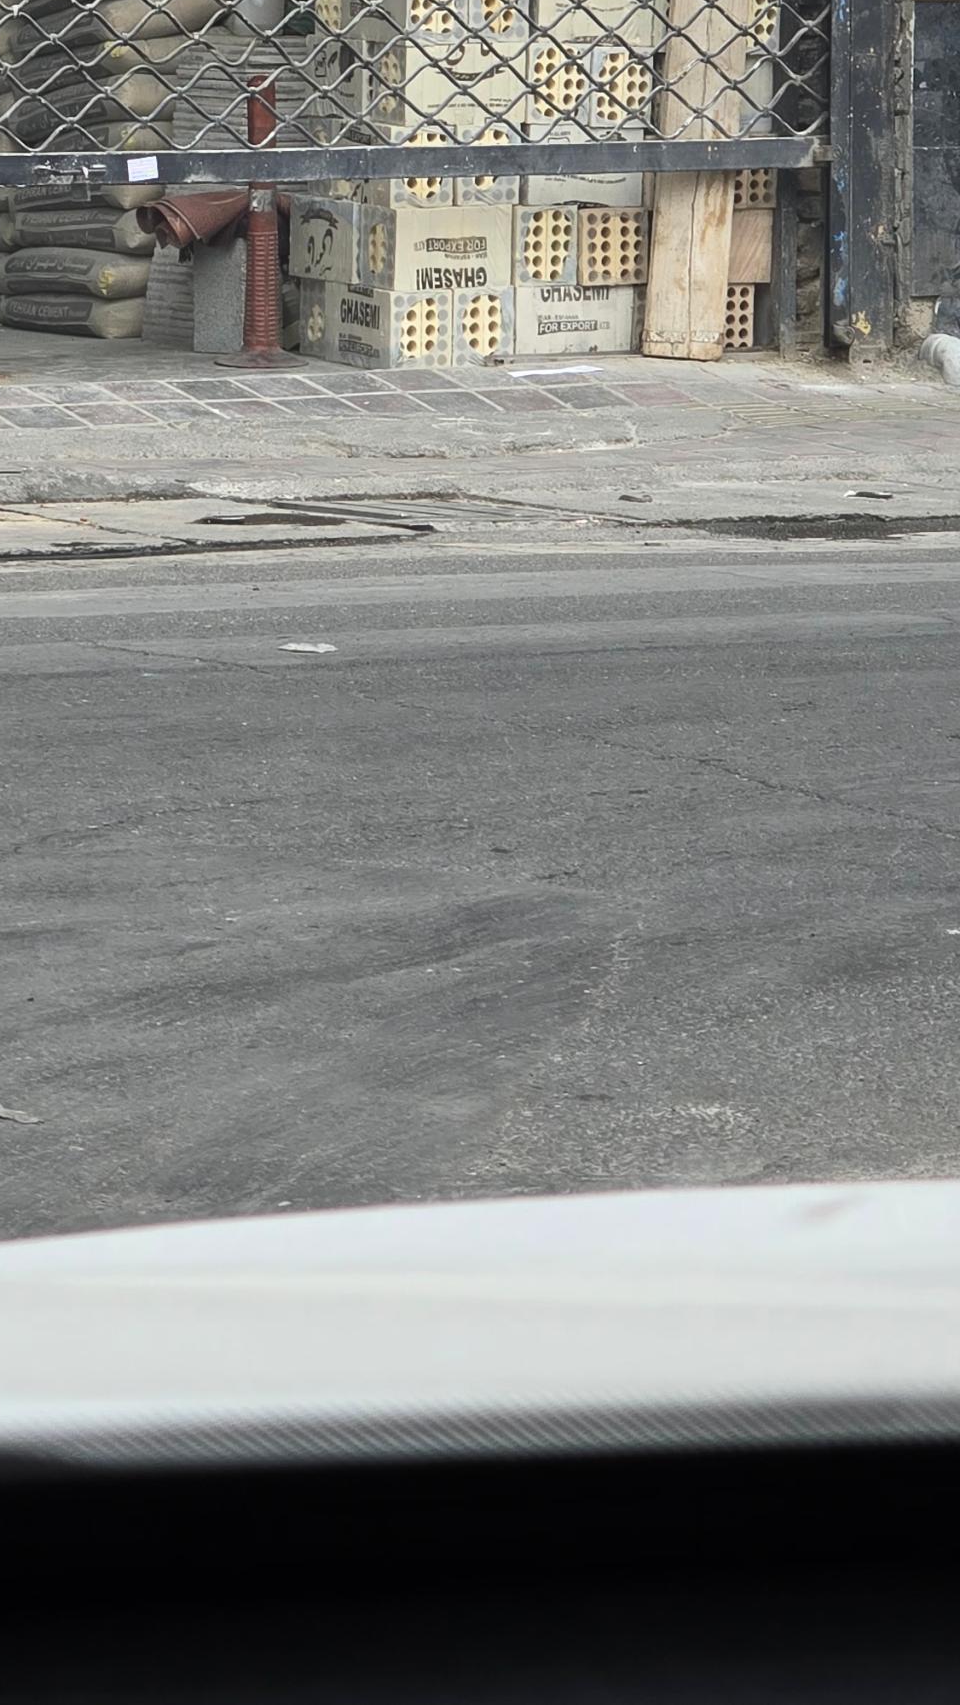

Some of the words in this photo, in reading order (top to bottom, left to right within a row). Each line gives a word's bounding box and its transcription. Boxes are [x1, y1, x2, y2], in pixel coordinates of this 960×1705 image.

[427, 238, 464, 252] EXPORT
[466, 238, 487, 251] FOR
[416, 266, 488, 291] GHASEMI
[540, 285, 609, 302] GHASEMI
[340, 298, 380, 330] GHASEMI
[539, 322, 558, 334] FOR
[560, 320, 596, 331] EXPORT
